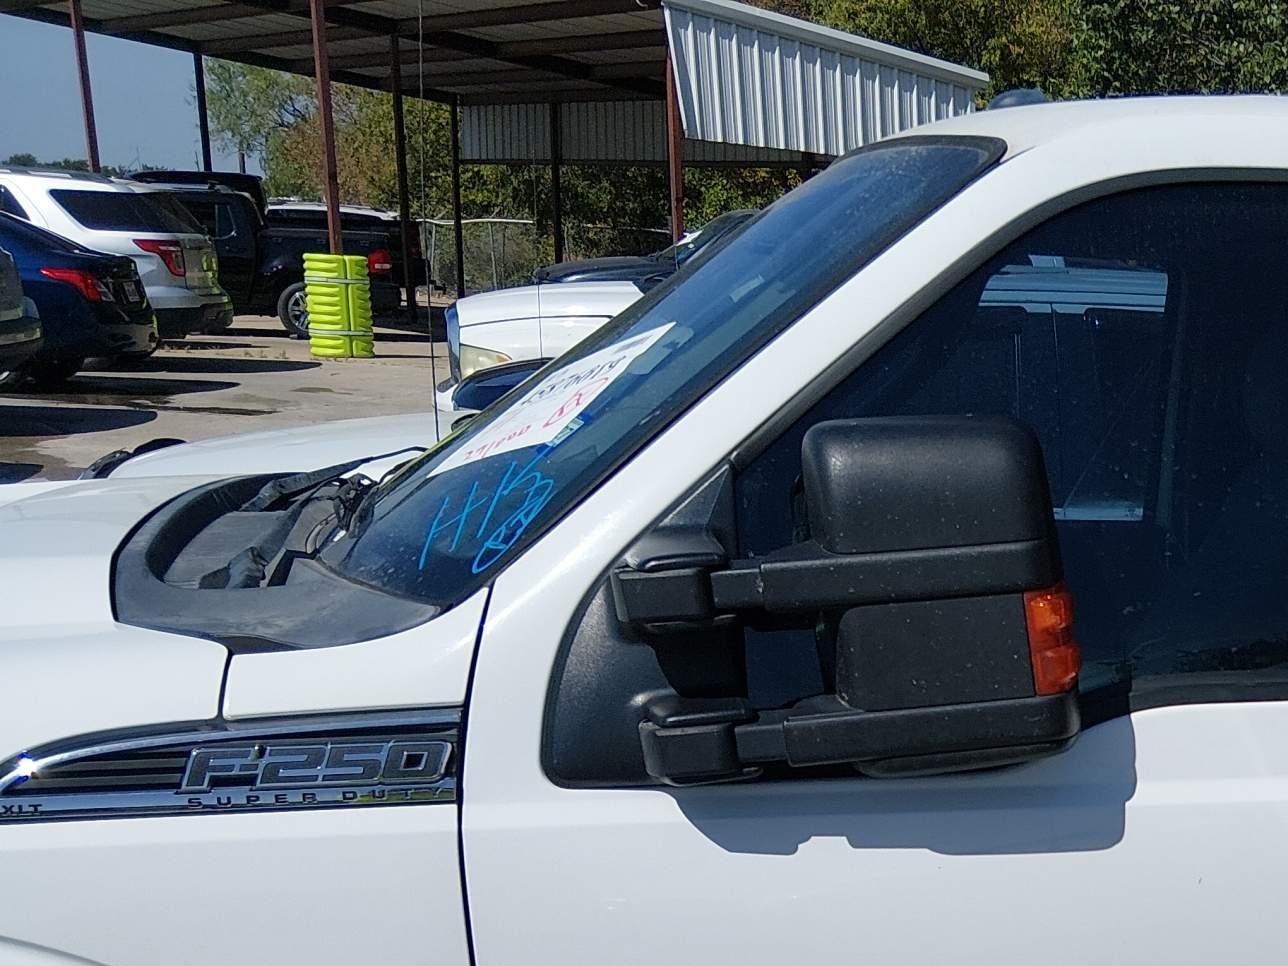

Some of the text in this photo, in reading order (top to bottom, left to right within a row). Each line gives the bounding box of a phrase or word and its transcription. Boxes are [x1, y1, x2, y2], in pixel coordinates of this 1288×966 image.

[188, 787, 443, 809] SUPER DUTY
[1, 804, 43, 816] XLT
